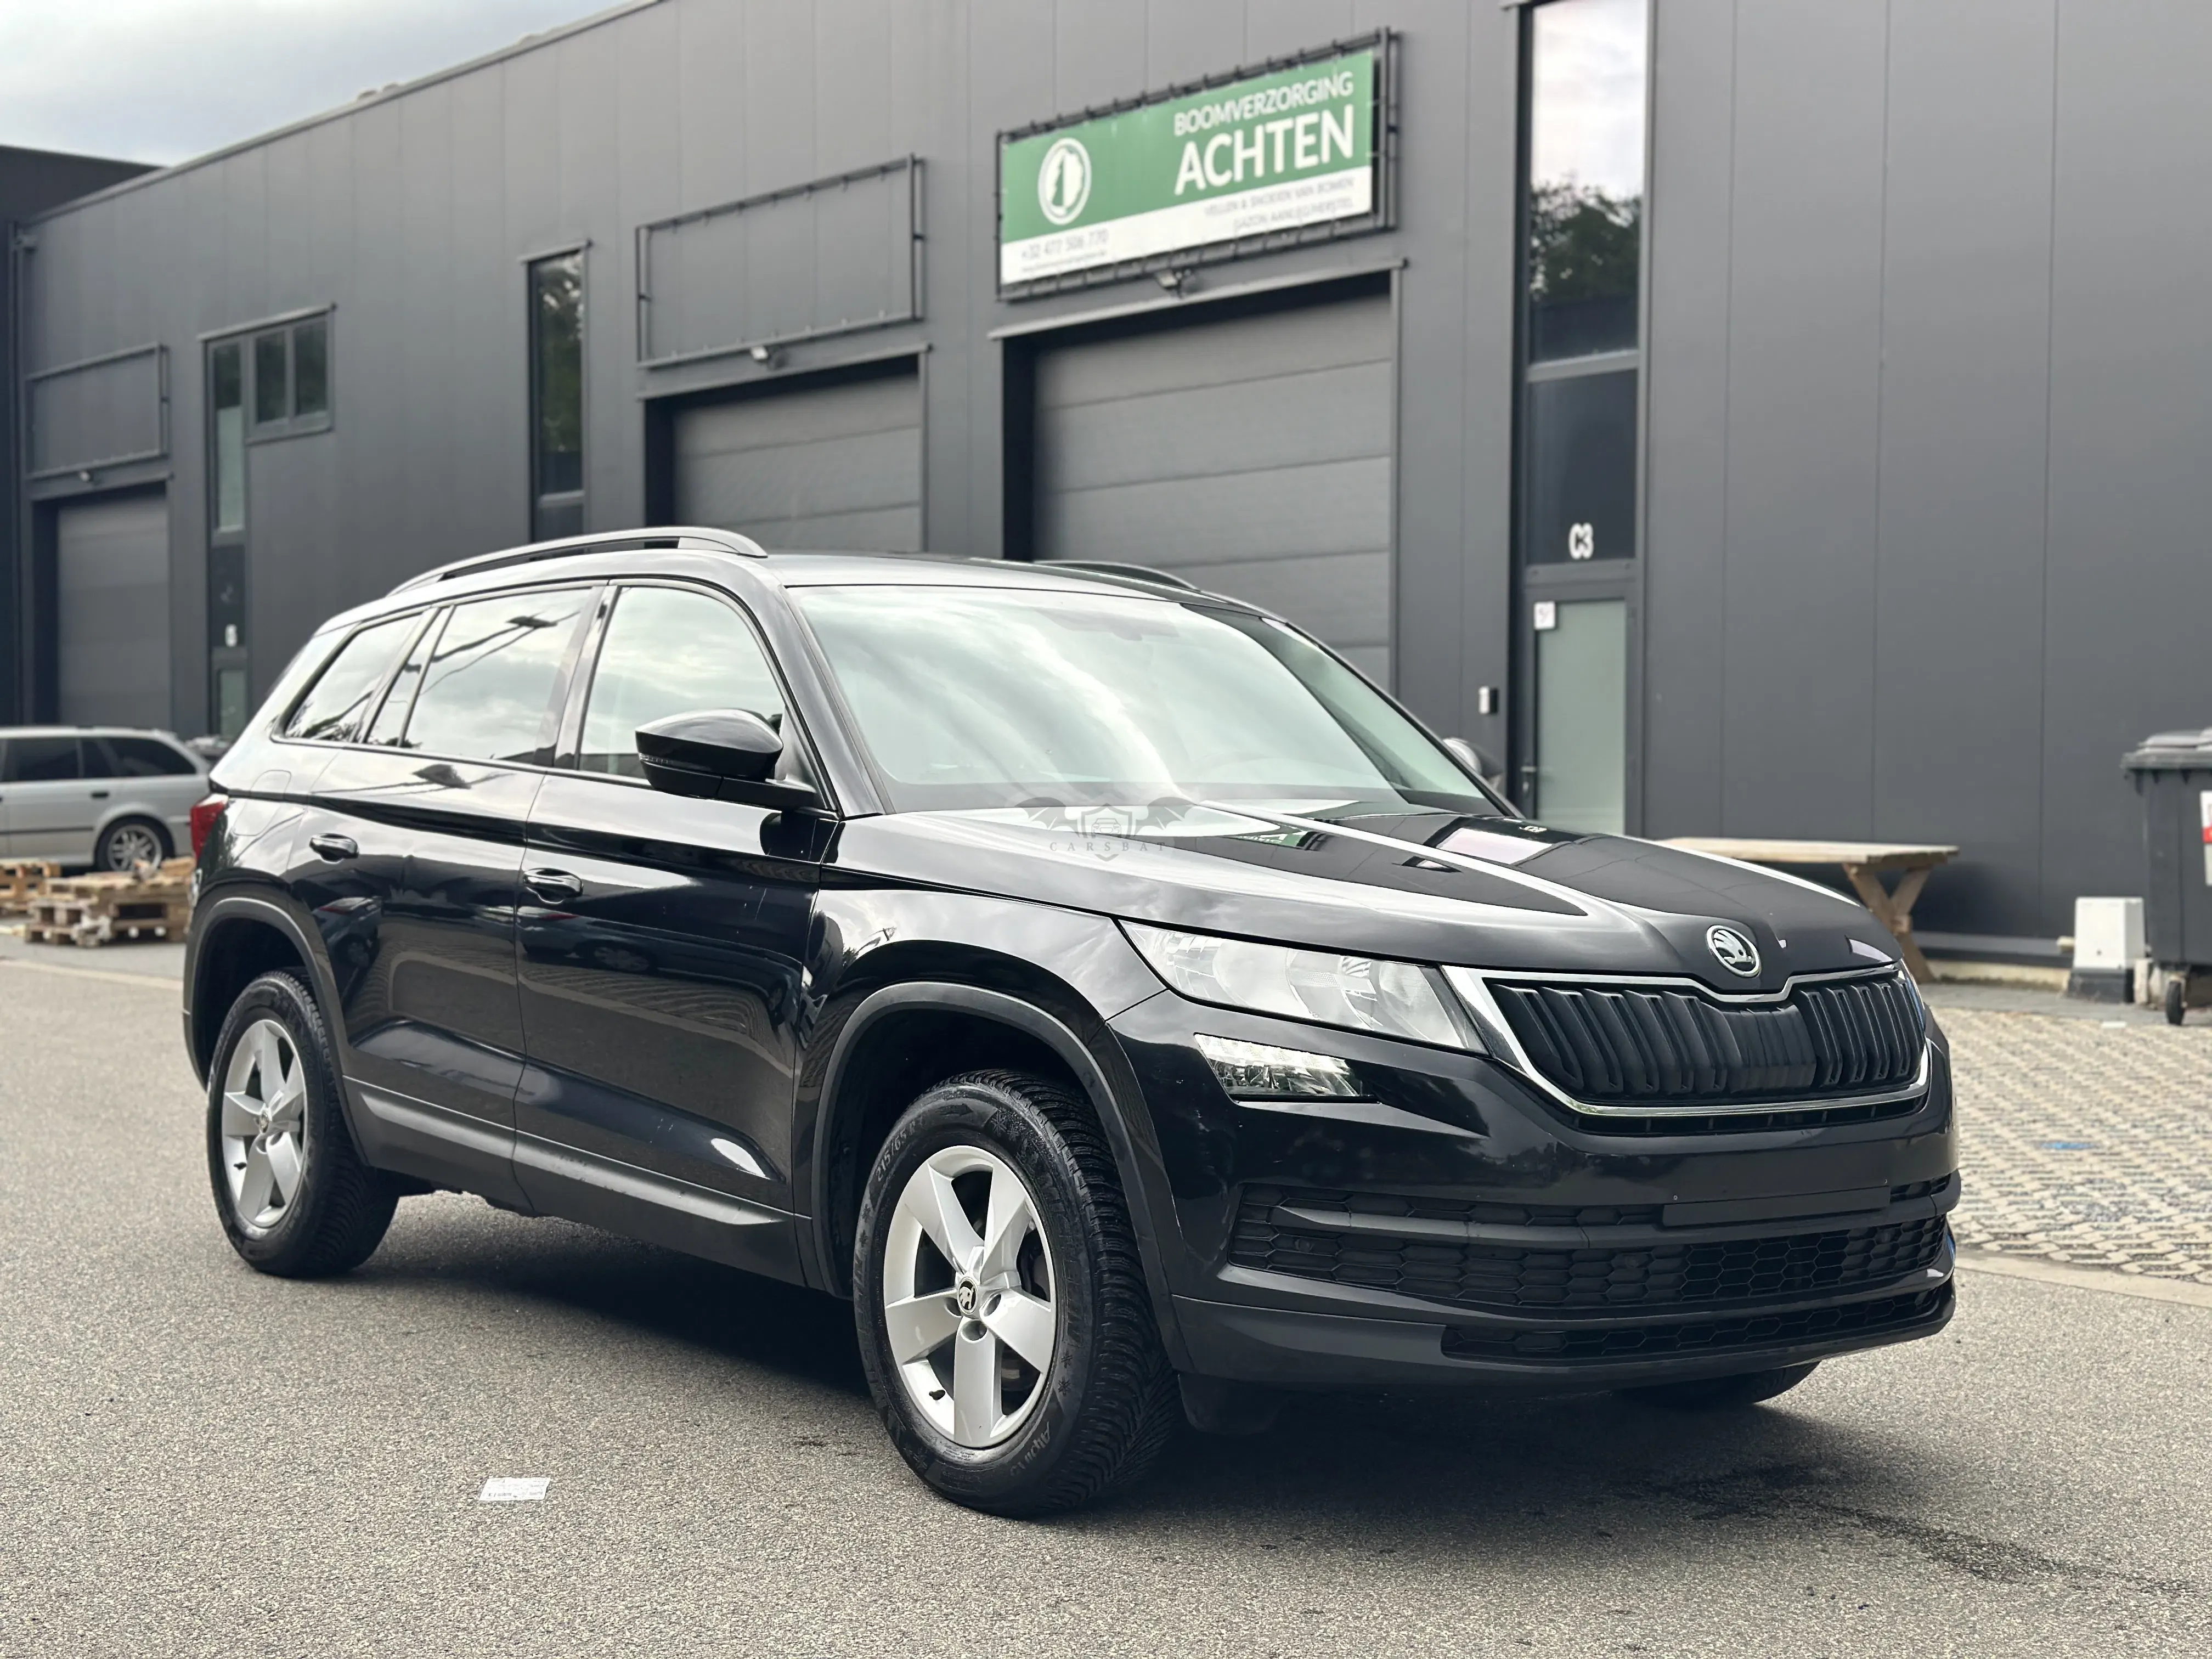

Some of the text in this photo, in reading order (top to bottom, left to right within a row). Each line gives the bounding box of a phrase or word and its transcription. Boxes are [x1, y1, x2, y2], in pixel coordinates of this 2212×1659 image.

[1174, 71, 1353, 137] BOOMVERZORGING
[1174, 103, 1353, 195] ACHTEN
[1568, 522, 1594, 560] C3
